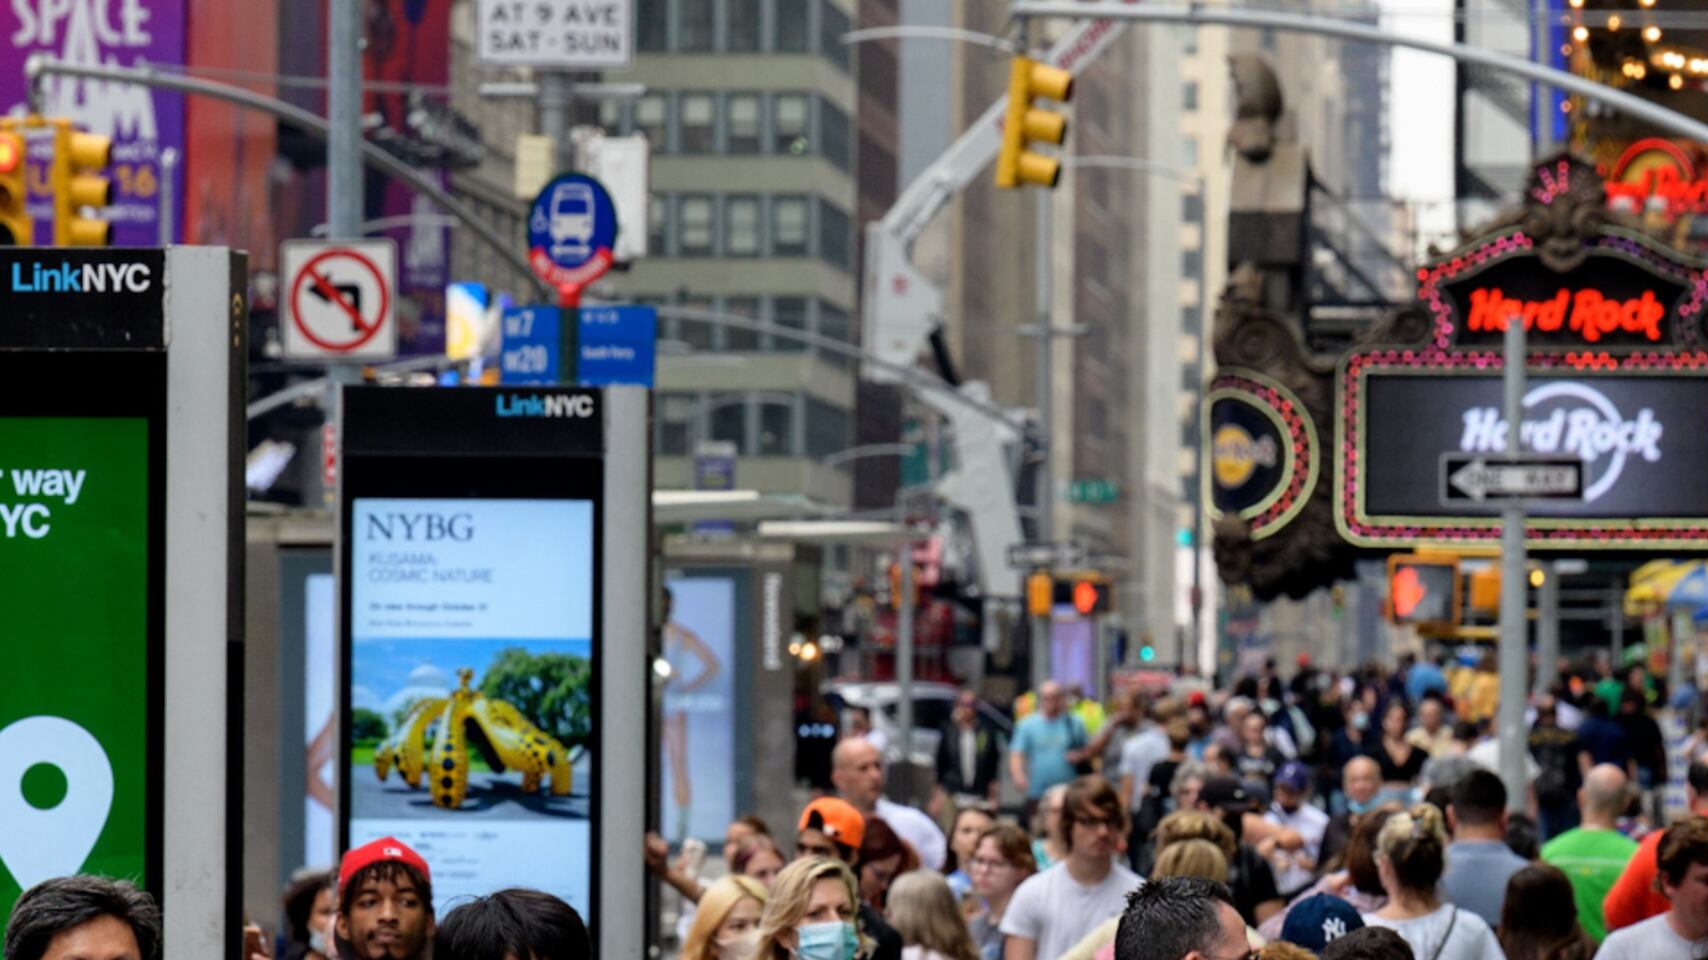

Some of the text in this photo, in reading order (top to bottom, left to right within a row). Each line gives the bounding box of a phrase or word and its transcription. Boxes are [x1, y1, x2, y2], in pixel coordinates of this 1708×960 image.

[490, 3, 617, 27] AT 9 AVE
[490, 30, 540, 50] SAT
[565, 30, 621, 52] SUN
[12, 262, 151, 293] LinkNYC
[1467, 288, 1571, 331] Hard
[1569, 288, 1664, 342] Rock
[496, 393, 594, 418] LinkNYC
[1564, 407, 1663, 463] Rock
[11, 469, 87, 504] way
[1468, 471, 1570, 487] ONE WAY
[366, 512, 475, 542] NYBG
[368, 567, 494, 584] COSMIC NATURE
